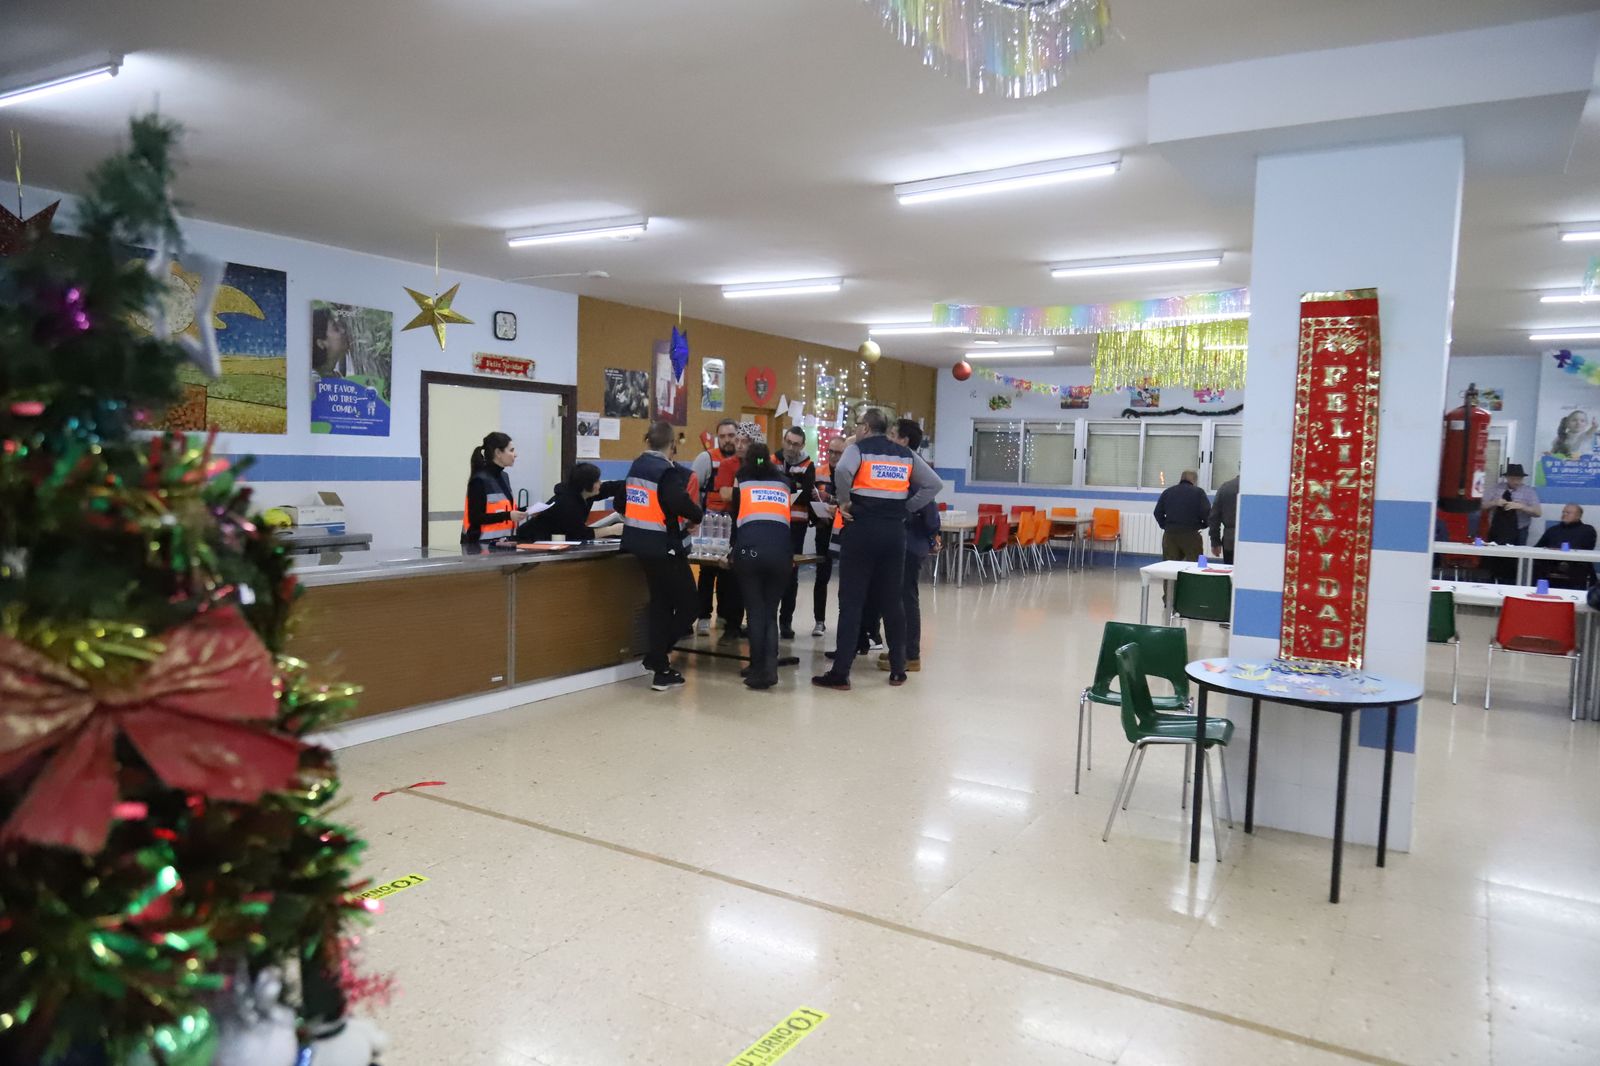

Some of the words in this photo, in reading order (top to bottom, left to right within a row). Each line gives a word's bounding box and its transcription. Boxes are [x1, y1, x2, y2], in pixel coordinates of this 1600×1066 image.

[318, 383, 332, 393] POR
[328, 394, 339, 402] NO
[1322, 365, 1360, 488] FELIZ
[876, 471, 905, 479] ZAMORA
[757, 494, 786, 503] ZAMORA
[1307, 479, 1344, 648] NAVIDAD
[746, 1027, 793, 1059] TURNO
